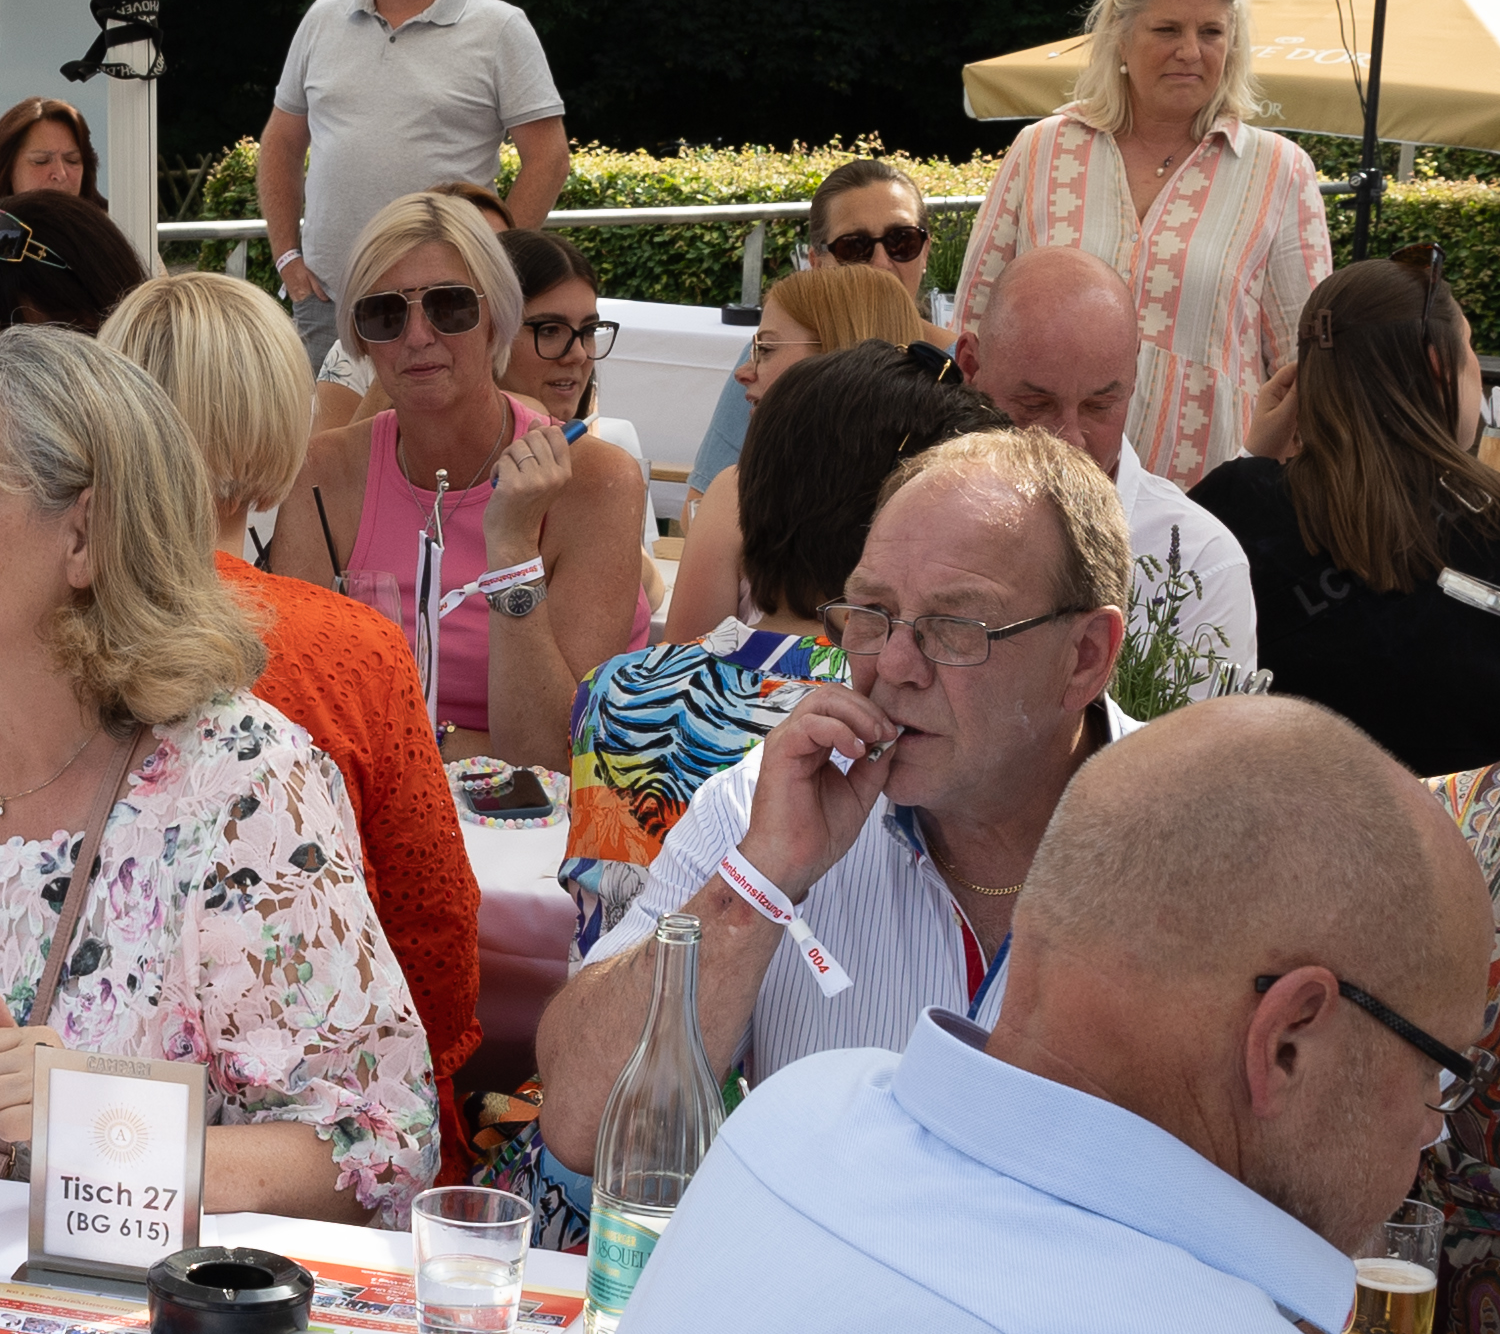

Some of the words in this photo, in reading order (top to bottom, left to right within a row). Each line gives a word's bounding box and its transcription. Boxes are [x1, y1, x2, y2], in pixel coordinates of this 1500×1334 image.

[808, 948, 830, 974] 004
[86, 1055, 152, 1077] CAMPARI
[60, 1175, 132, 1207] Tisch
[143, 1186, 178, 1212] 27
[66, 1210, 111, 1235] (BG
[119, 1218, 169, 1247] 615)
